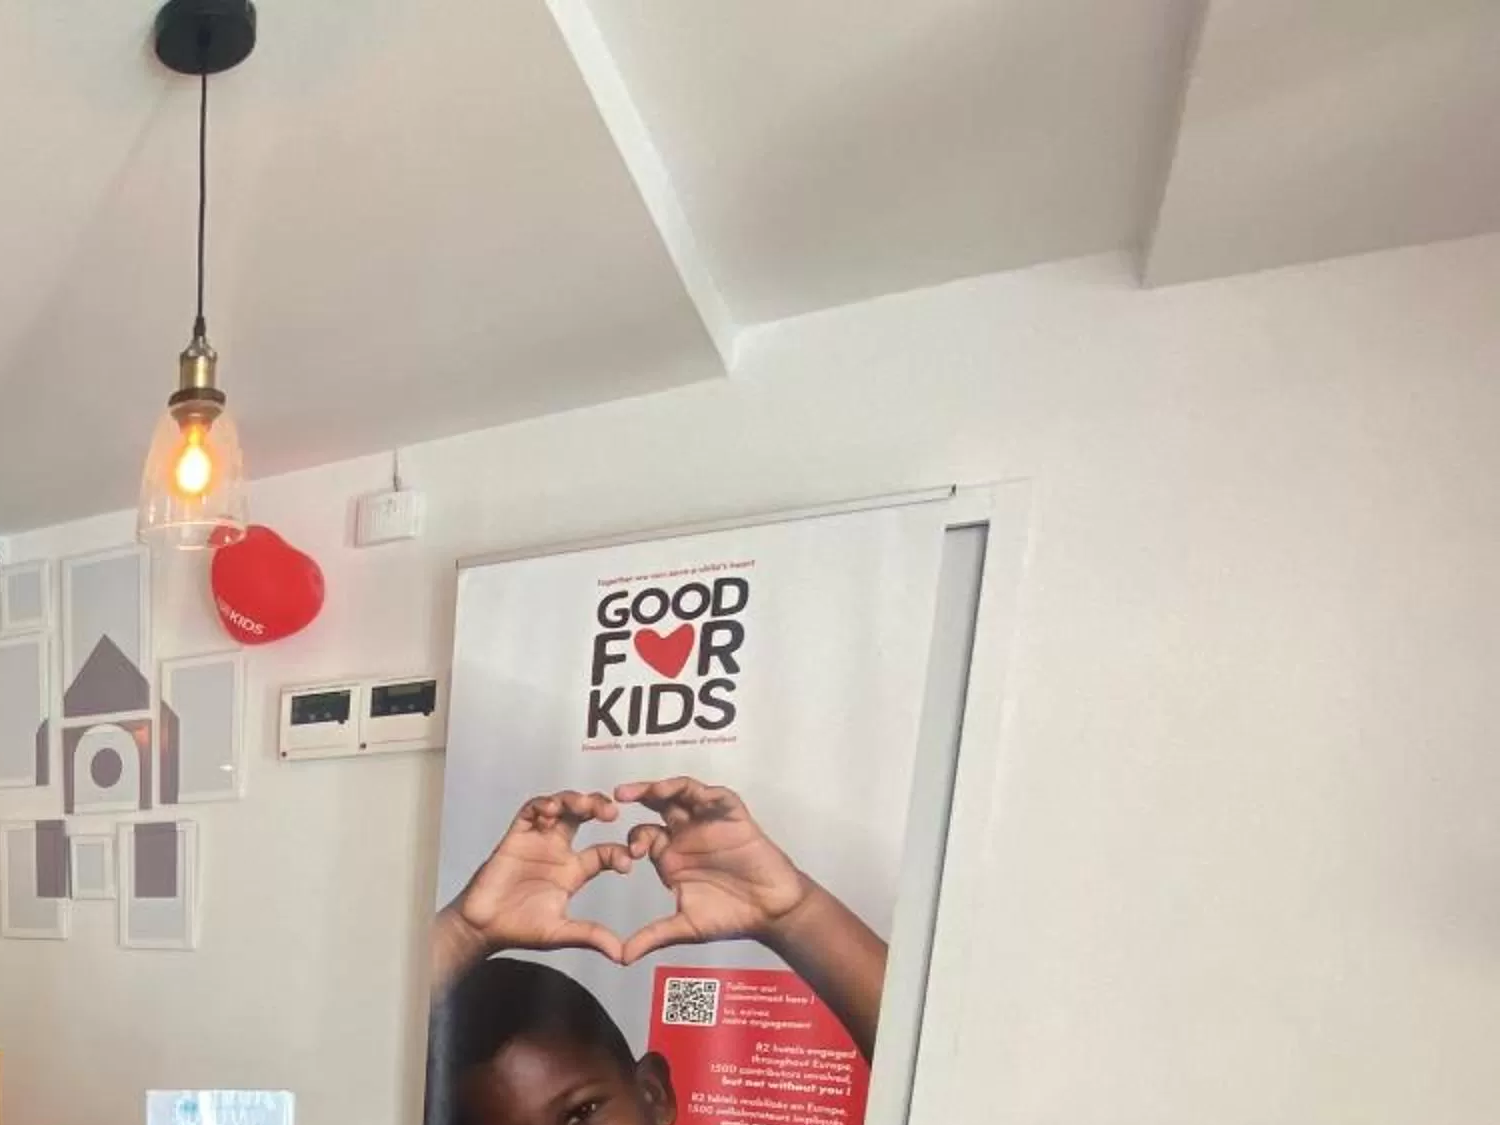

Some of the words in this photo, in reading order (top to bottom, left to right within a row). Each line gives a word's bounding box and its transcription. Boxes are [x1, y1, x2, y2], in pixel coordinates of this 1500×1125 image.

[597, 577, 749, 628] GOOD
[587, 678, 737, 738] KIDS
[768, 1079, 816, 1093] without
[819, 1086, 845, 1096] you
